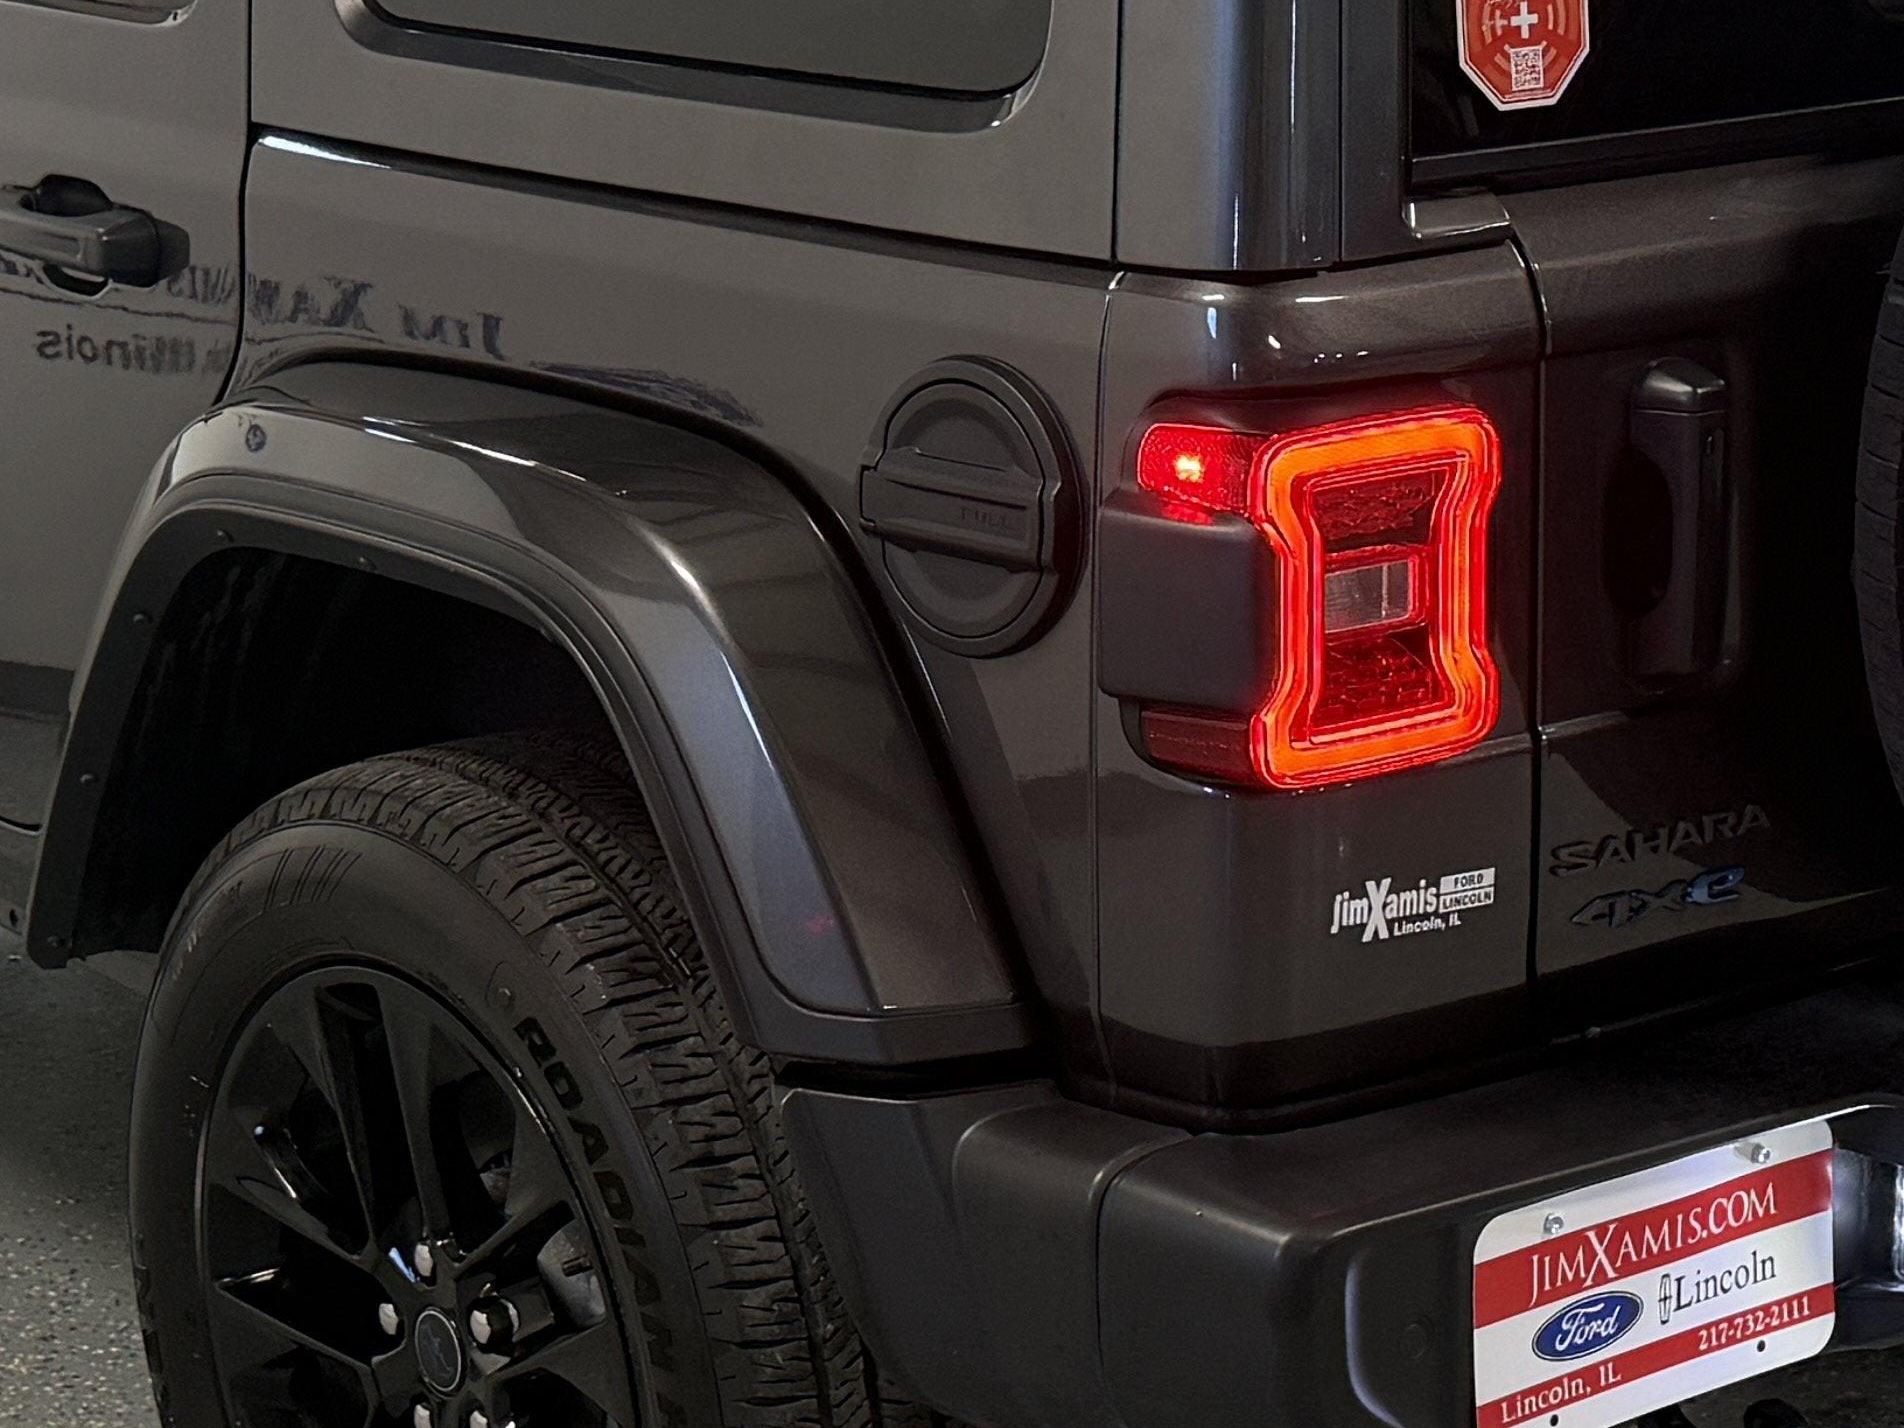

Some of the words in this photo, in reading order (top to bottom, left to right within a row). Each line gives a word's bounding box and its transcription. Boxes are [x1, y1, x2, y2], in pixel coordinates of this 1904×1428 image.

[1549, 803, 1771, 876] SAHARA
[1443, 891, 1492, 908] LINCOLN
[1450, 913, 1461, 926] IL
[1674, 1250, 1778, 1314] Lincoln
[1555, 1302, 1620, 1352] Ford
[1699, 1297, 1811, 1351] 217-732-2111
[1501, 1375, 1592, 1425] Lincoln,
[1599, 1364, 1622, 1388] IL
